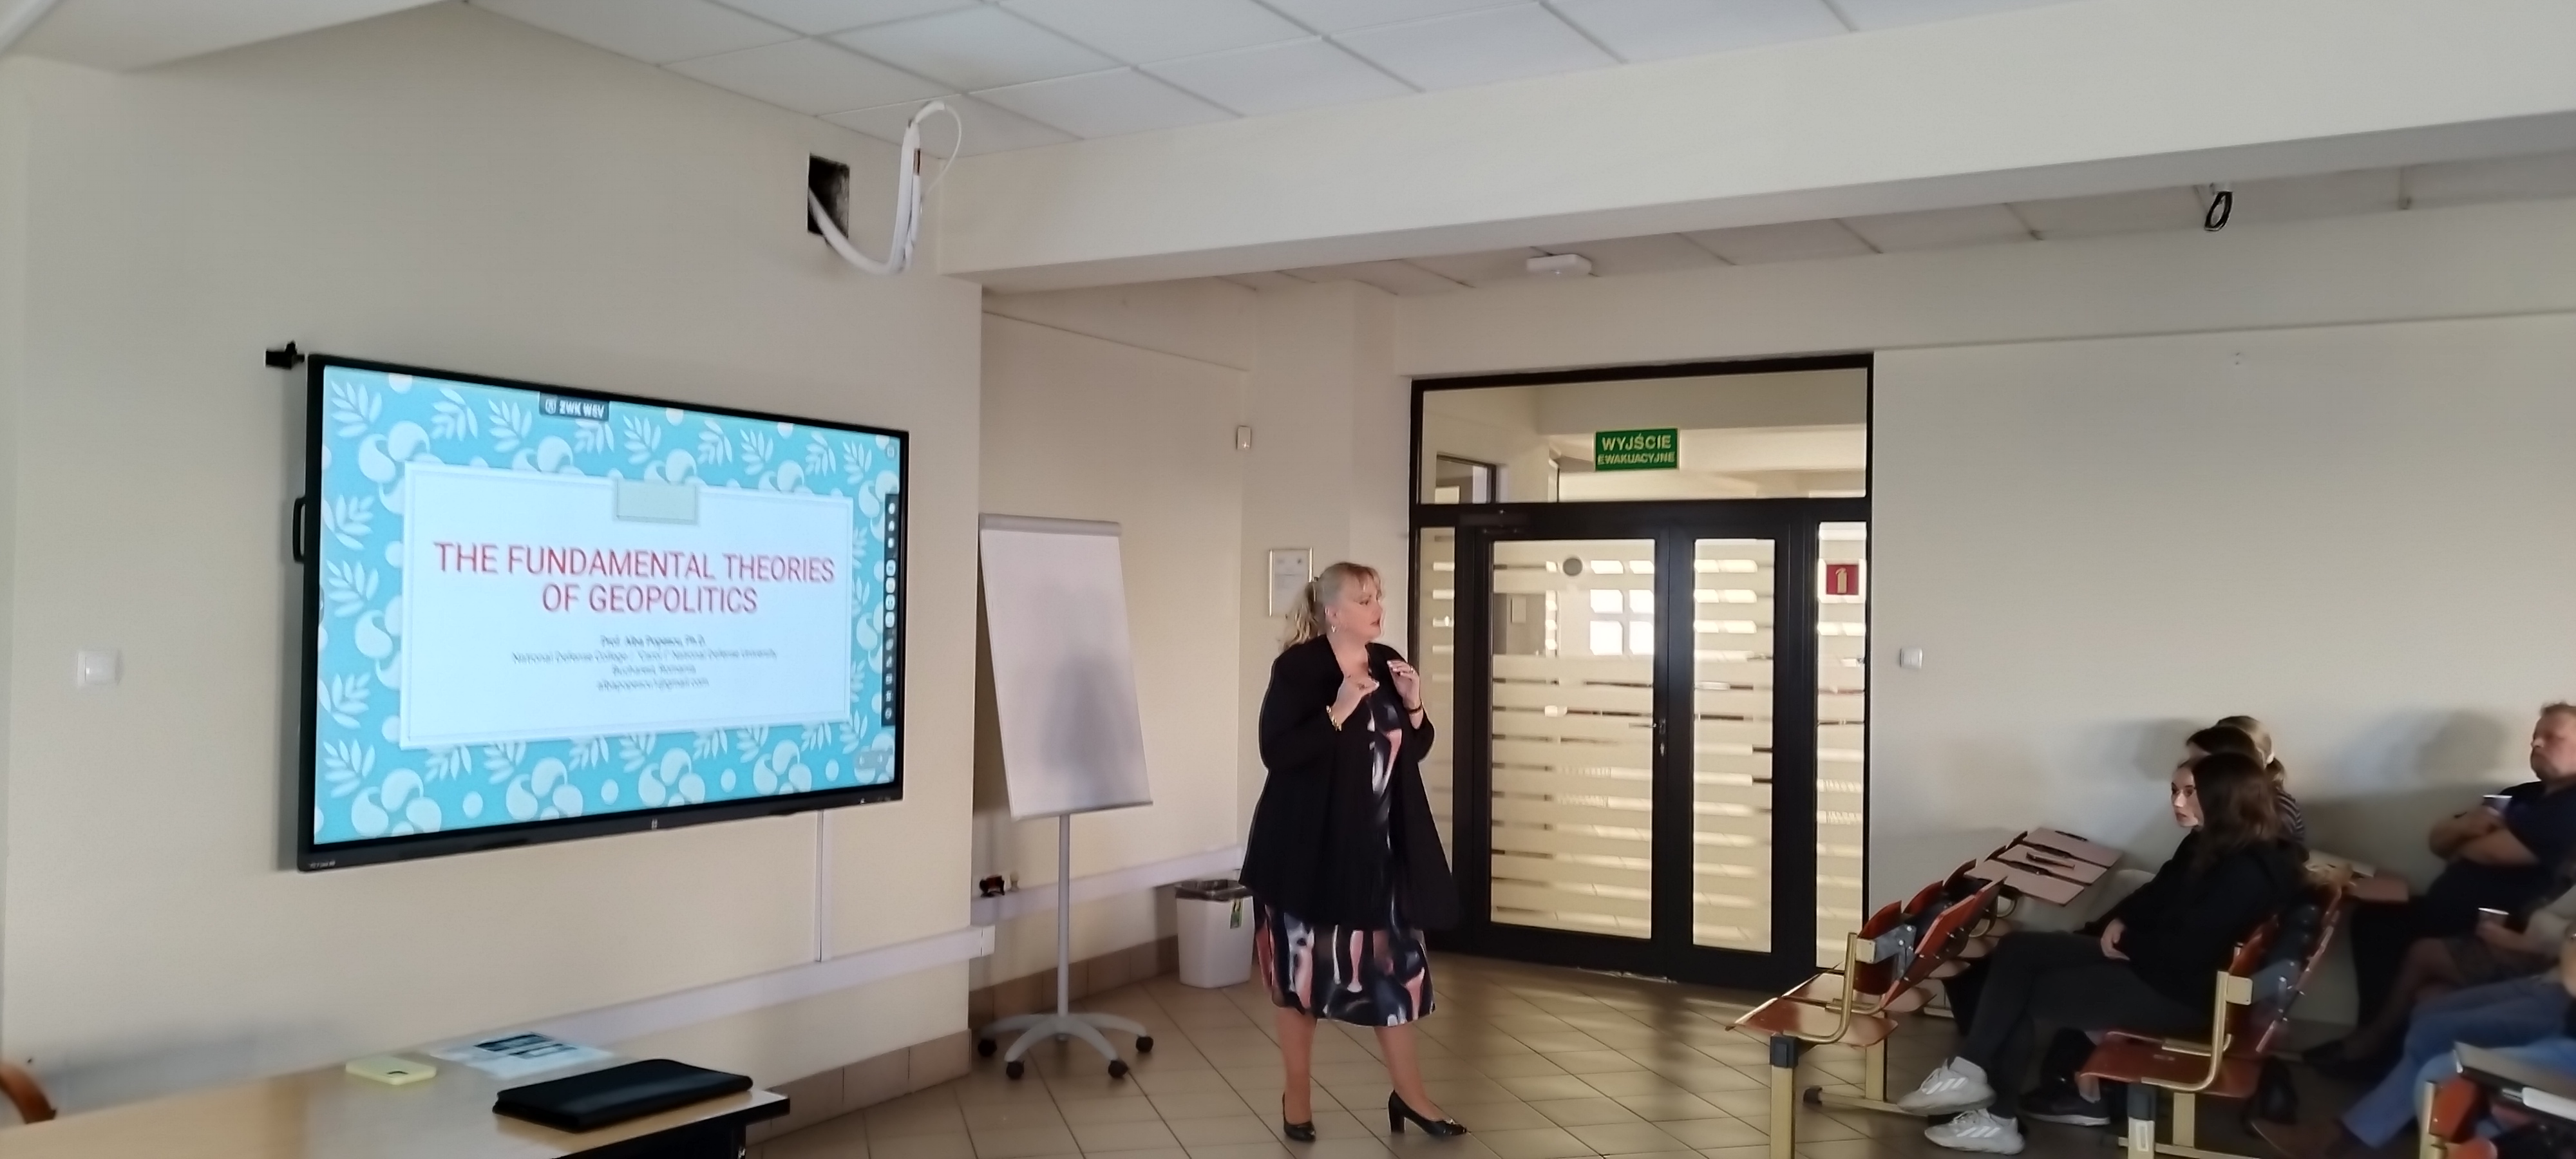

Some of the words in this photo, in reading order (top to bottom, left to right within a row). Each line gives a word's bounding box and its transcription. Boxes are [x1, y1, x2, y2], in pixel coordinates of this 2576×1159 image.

[1602, 433, 1671, 451] WYJŚCIE
[1598, 452, 1674, 465] EWAKUACYJNE
[433, 542, 498, 574] THE
[508, 545, 715, 579] FUNDAMENTAL
[723, 553, 835, 583] THEORIES
[542, 584, 579, 612] OF
[589, 585, 757, 613] GEOPOLITICS
